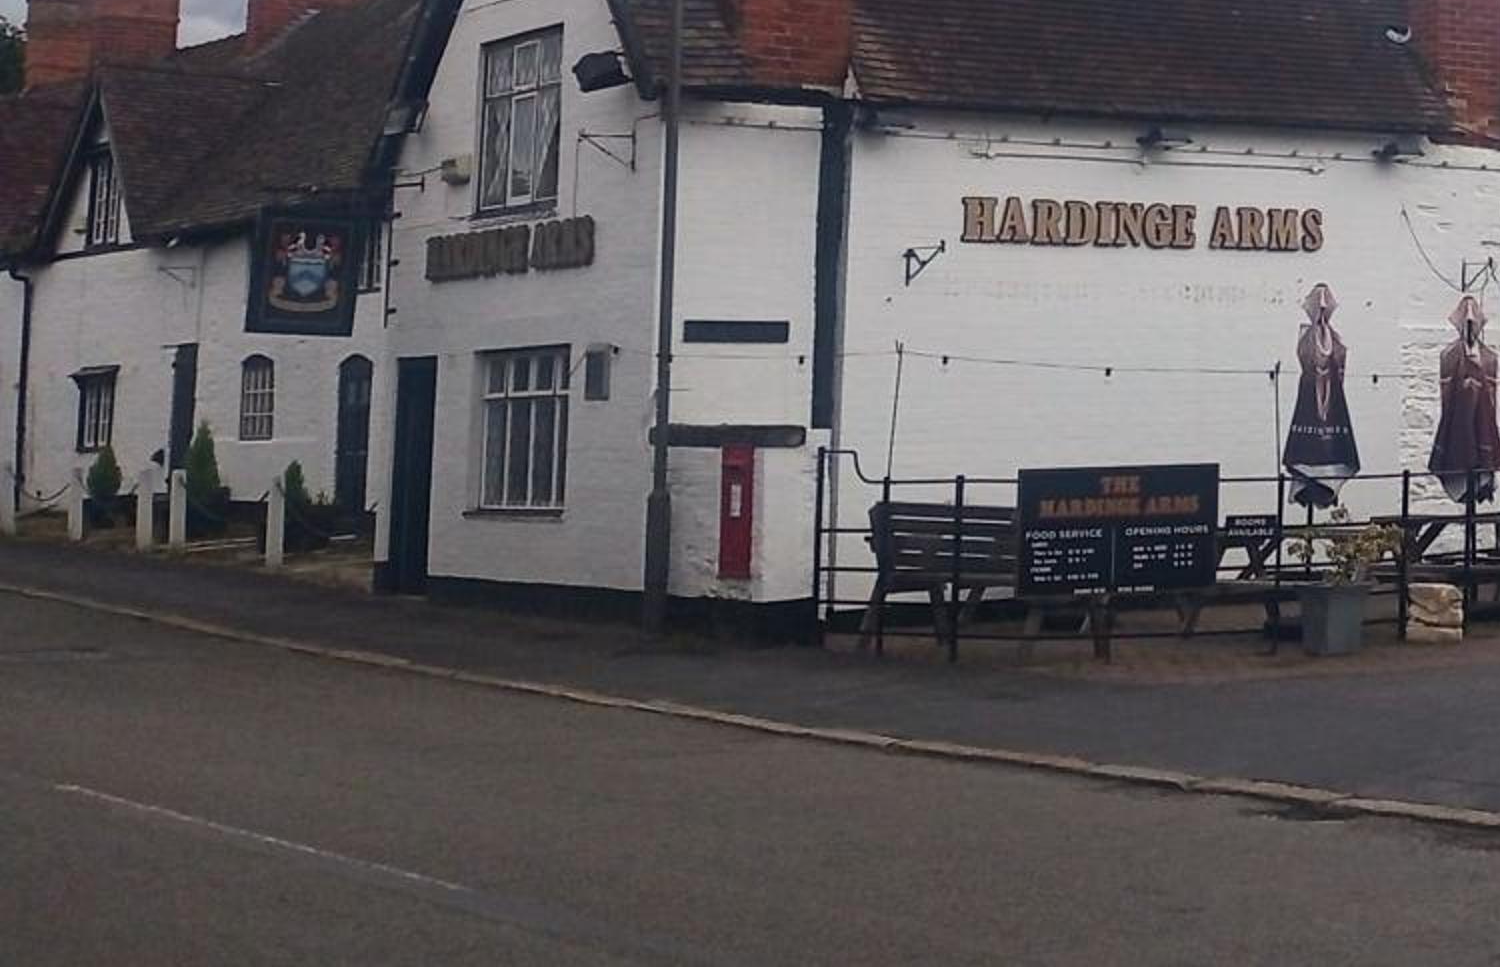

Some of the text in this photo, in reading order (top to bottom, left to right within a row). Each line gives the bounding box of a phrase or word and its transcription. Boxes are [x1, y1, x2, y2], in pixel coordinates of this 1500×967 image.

[960, 196, 1324, 252] HARDINGE ARMS
[1100, 475, 1141, 494] THE
[1039, 494, 1200, 518] HARDINGE ARMS
[1235, 518, 1266, 526] ROOMS
[1026, 528, 1103, 540] FOOD SERVICE
[1125, 524, 1209, 536] OPENING HOURS
[1228, 527, 1274, 537] AVAILABLE
